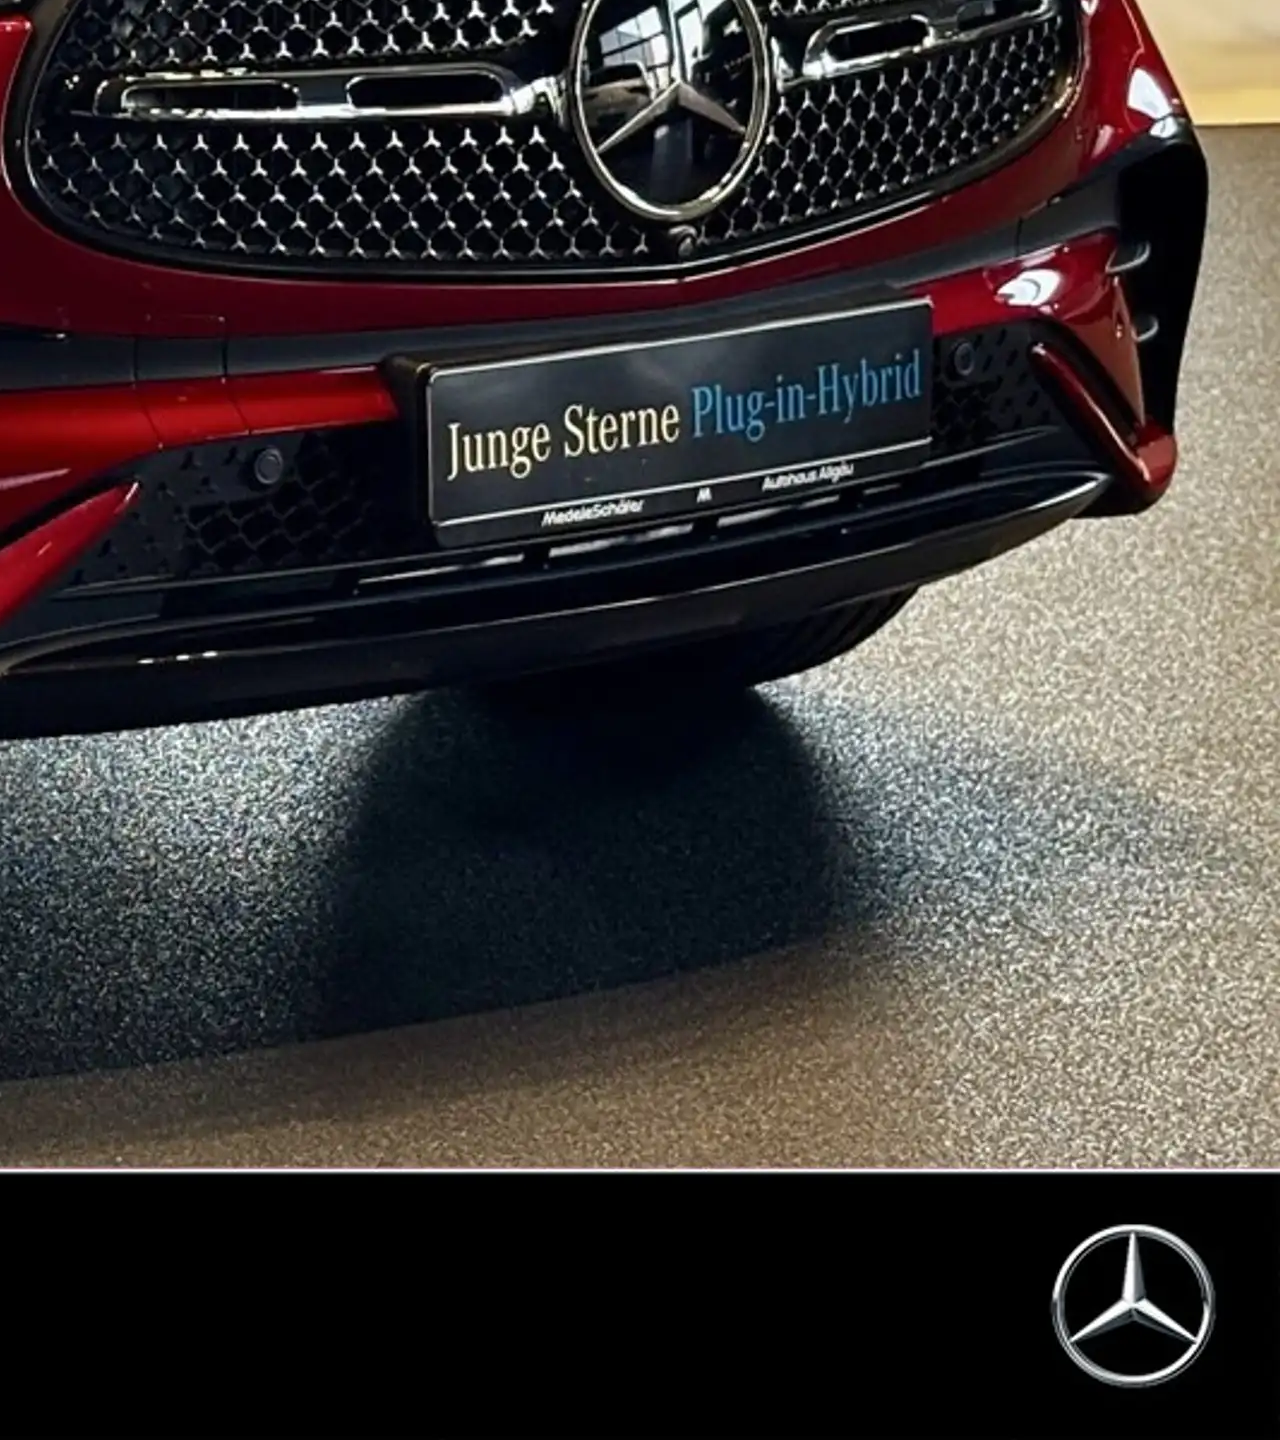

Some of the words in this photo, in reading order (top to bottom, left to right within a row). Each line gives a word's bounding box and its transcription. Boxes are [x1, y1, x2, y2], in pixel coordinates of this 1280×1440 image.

[445, 420, 552, 481] Junge
[563, 403, 681, 459] Sterne
[690, 348, 922, 442] Plug-in-Hybrid
